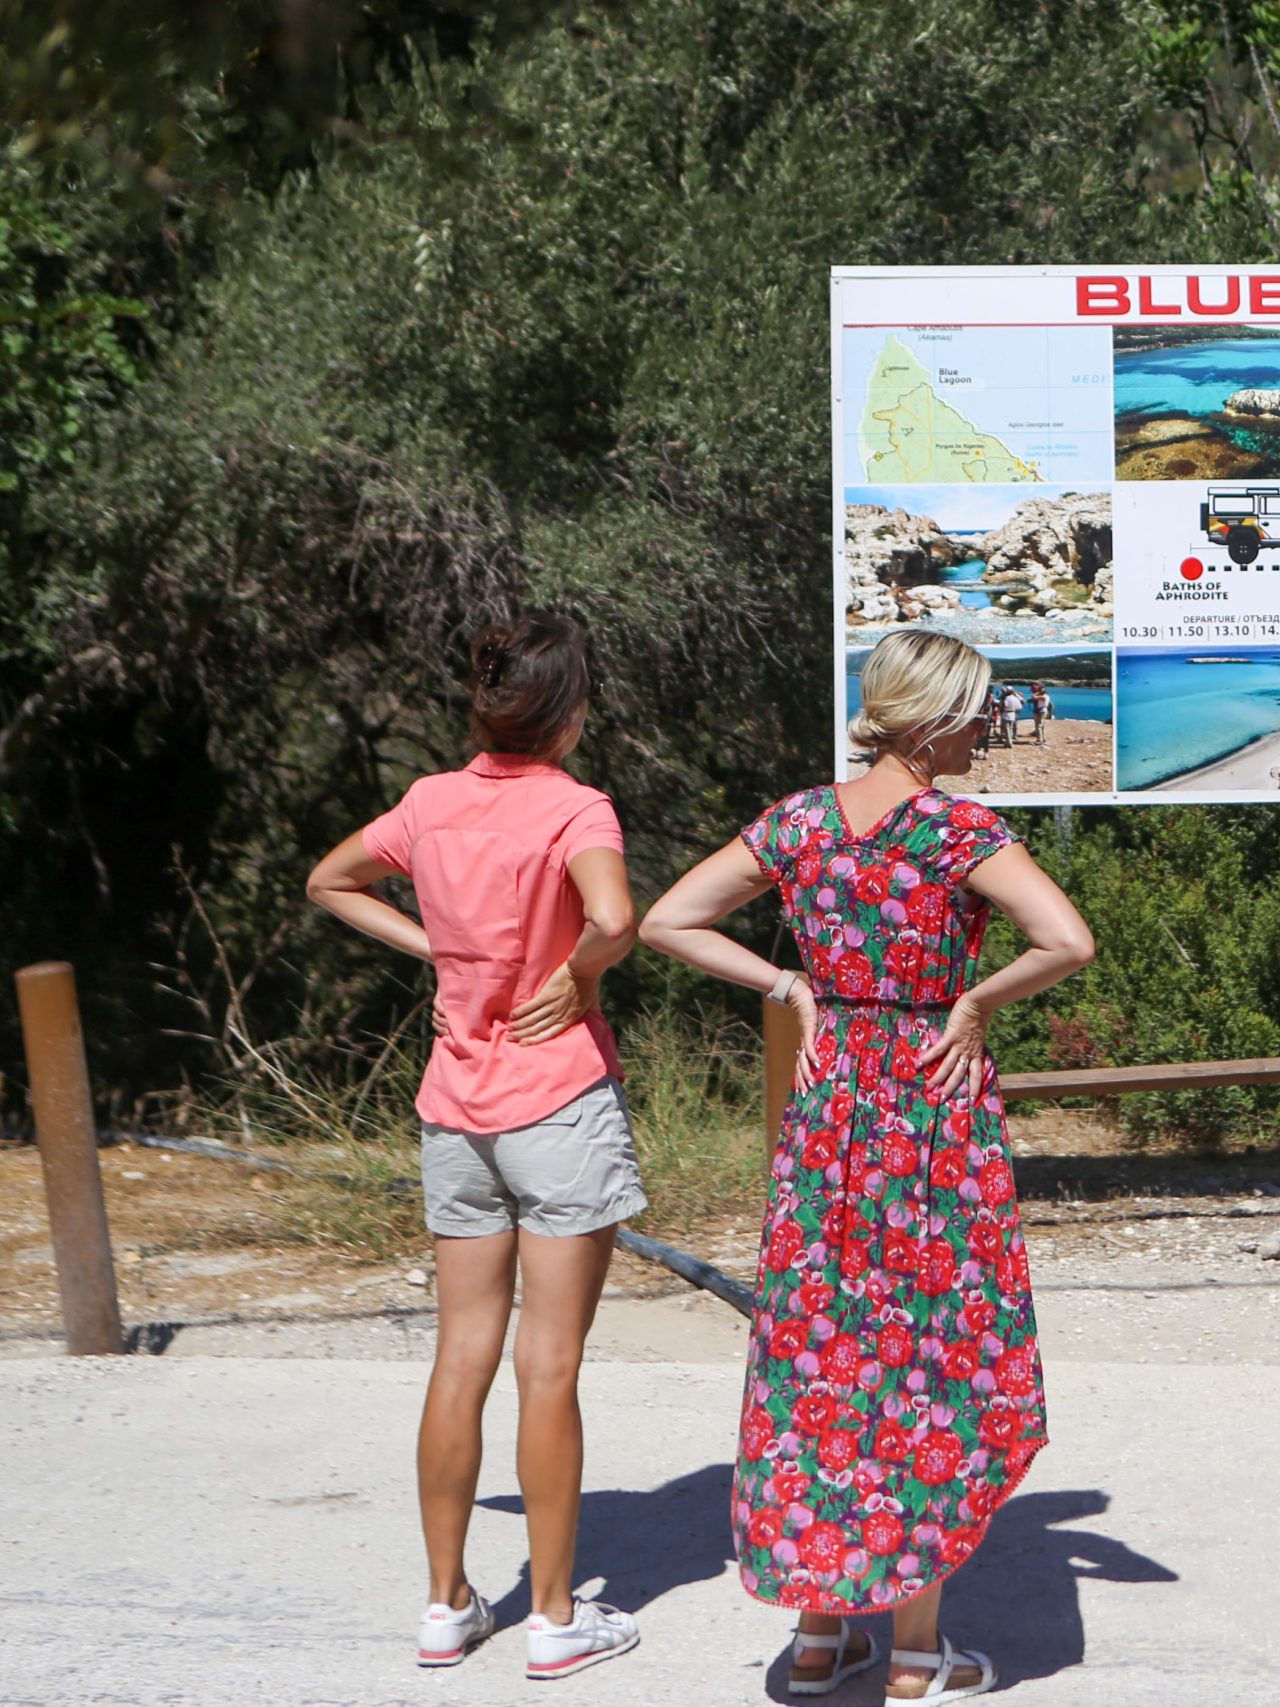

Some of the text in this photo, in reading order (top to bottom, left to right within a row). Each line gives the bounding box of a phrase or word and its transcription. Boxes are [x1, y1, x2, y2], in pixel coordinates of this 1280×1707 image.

[938, 367, 959, 376] Blue
[938, 377, 973, 386] Lagoon
[1162, 581, 1222, 592] BATHS OF
[1155, 591, 1229, 601] APHRODITE
[1183, 615, 1236, 624] DEPARTURE
[1243, 614, 1280, 625] ОТЪЕЗД
[1122, 626, 1158, 638] 10.30
[1168, 625, 1204, 637] 11.50
[1214, 624, 1250, 636] 13.10
